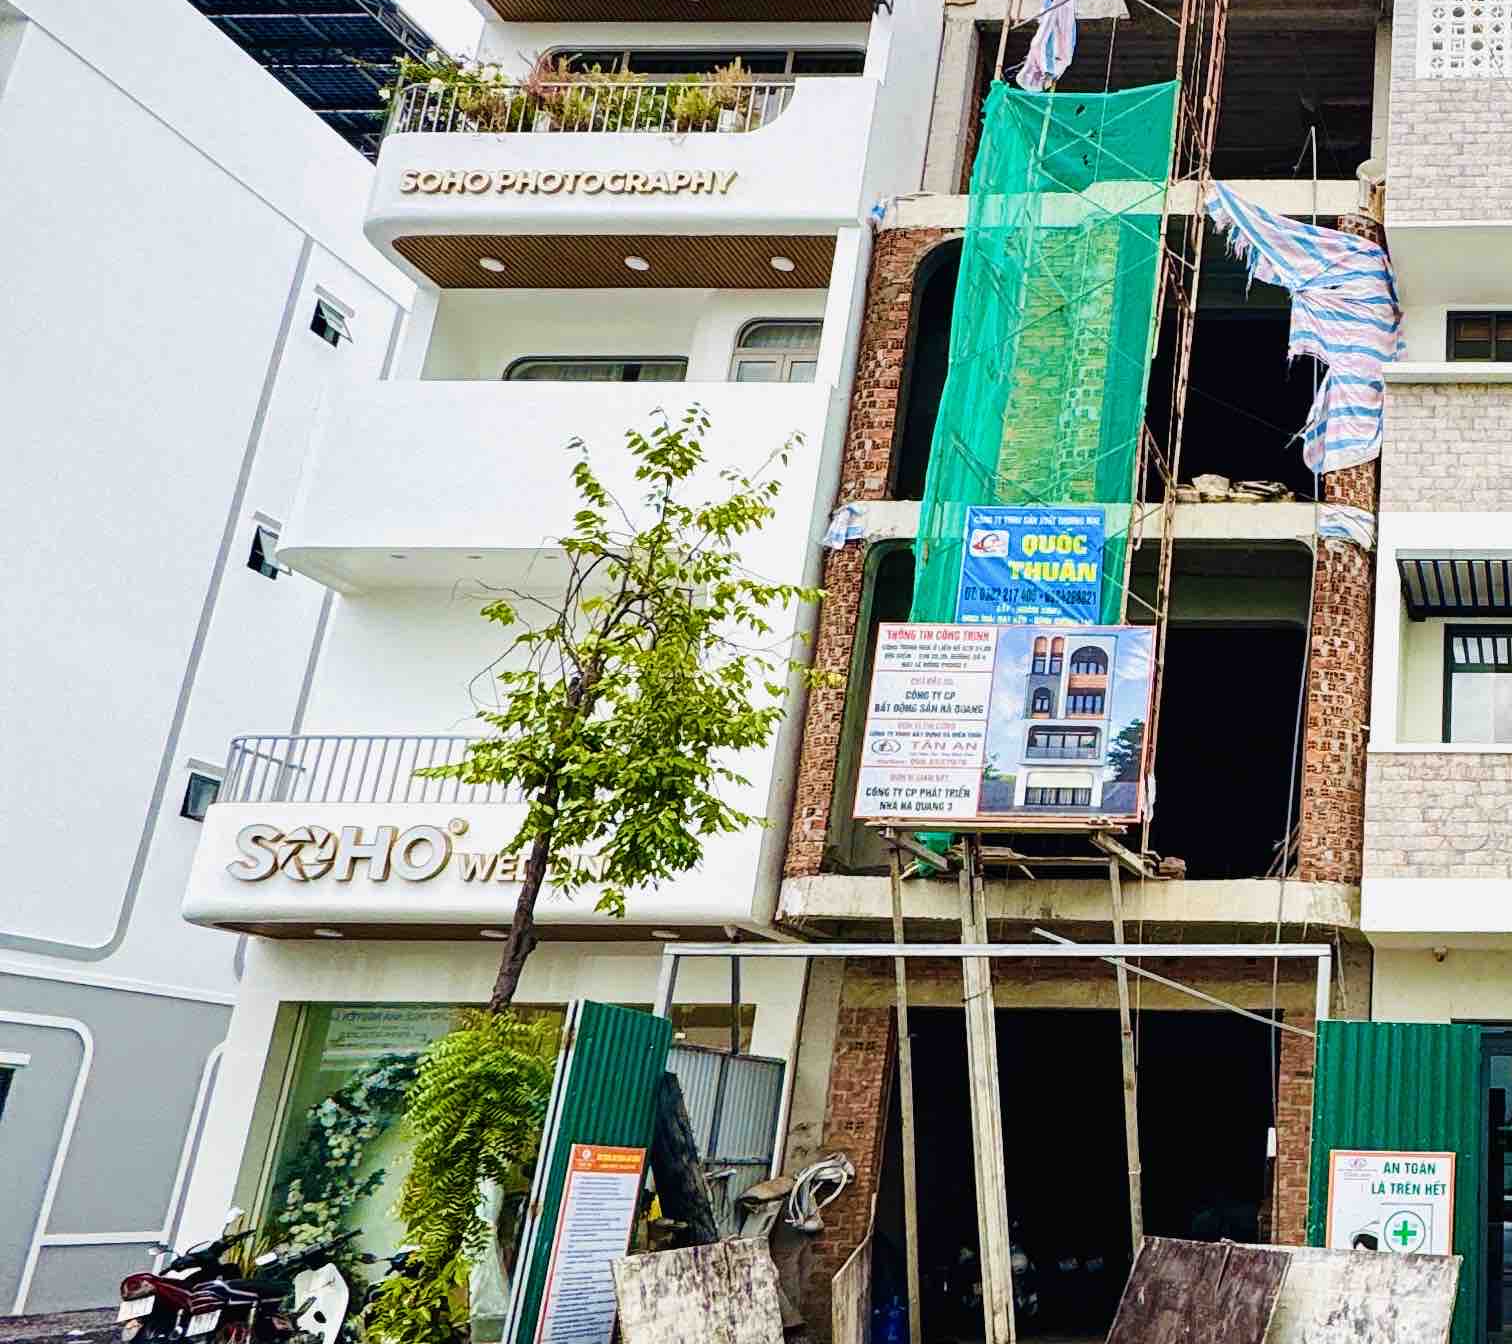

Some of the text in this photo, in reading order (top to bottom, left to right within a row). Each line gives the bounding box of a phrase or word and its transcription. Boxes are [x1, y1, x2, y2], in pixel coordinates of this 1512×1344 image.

[400, 169, 738, 196] SOHO PHOTOGRAPHY
[1022, 528, 1088, 557] QUỐC
[1008, 559, 1098, 585] THUẬN
[931, 690, 942, 700] TY
[943, 690, 956, 700] CP
[951, 741, 978, 751] AN
[865, 785, 890, 797] CÔNG
[892, 787, 903, 797] TY
[905, 787, 918, 798] CP
[915, 801, 945, 812] QUANG
[225, 822, 455, 882] SOHO
[1383, 1162, 1399, 1174] AN
[1390, 1180, 1420, 1195] TRÊN
[1425, 1179, 1447, 1196] HẾT
